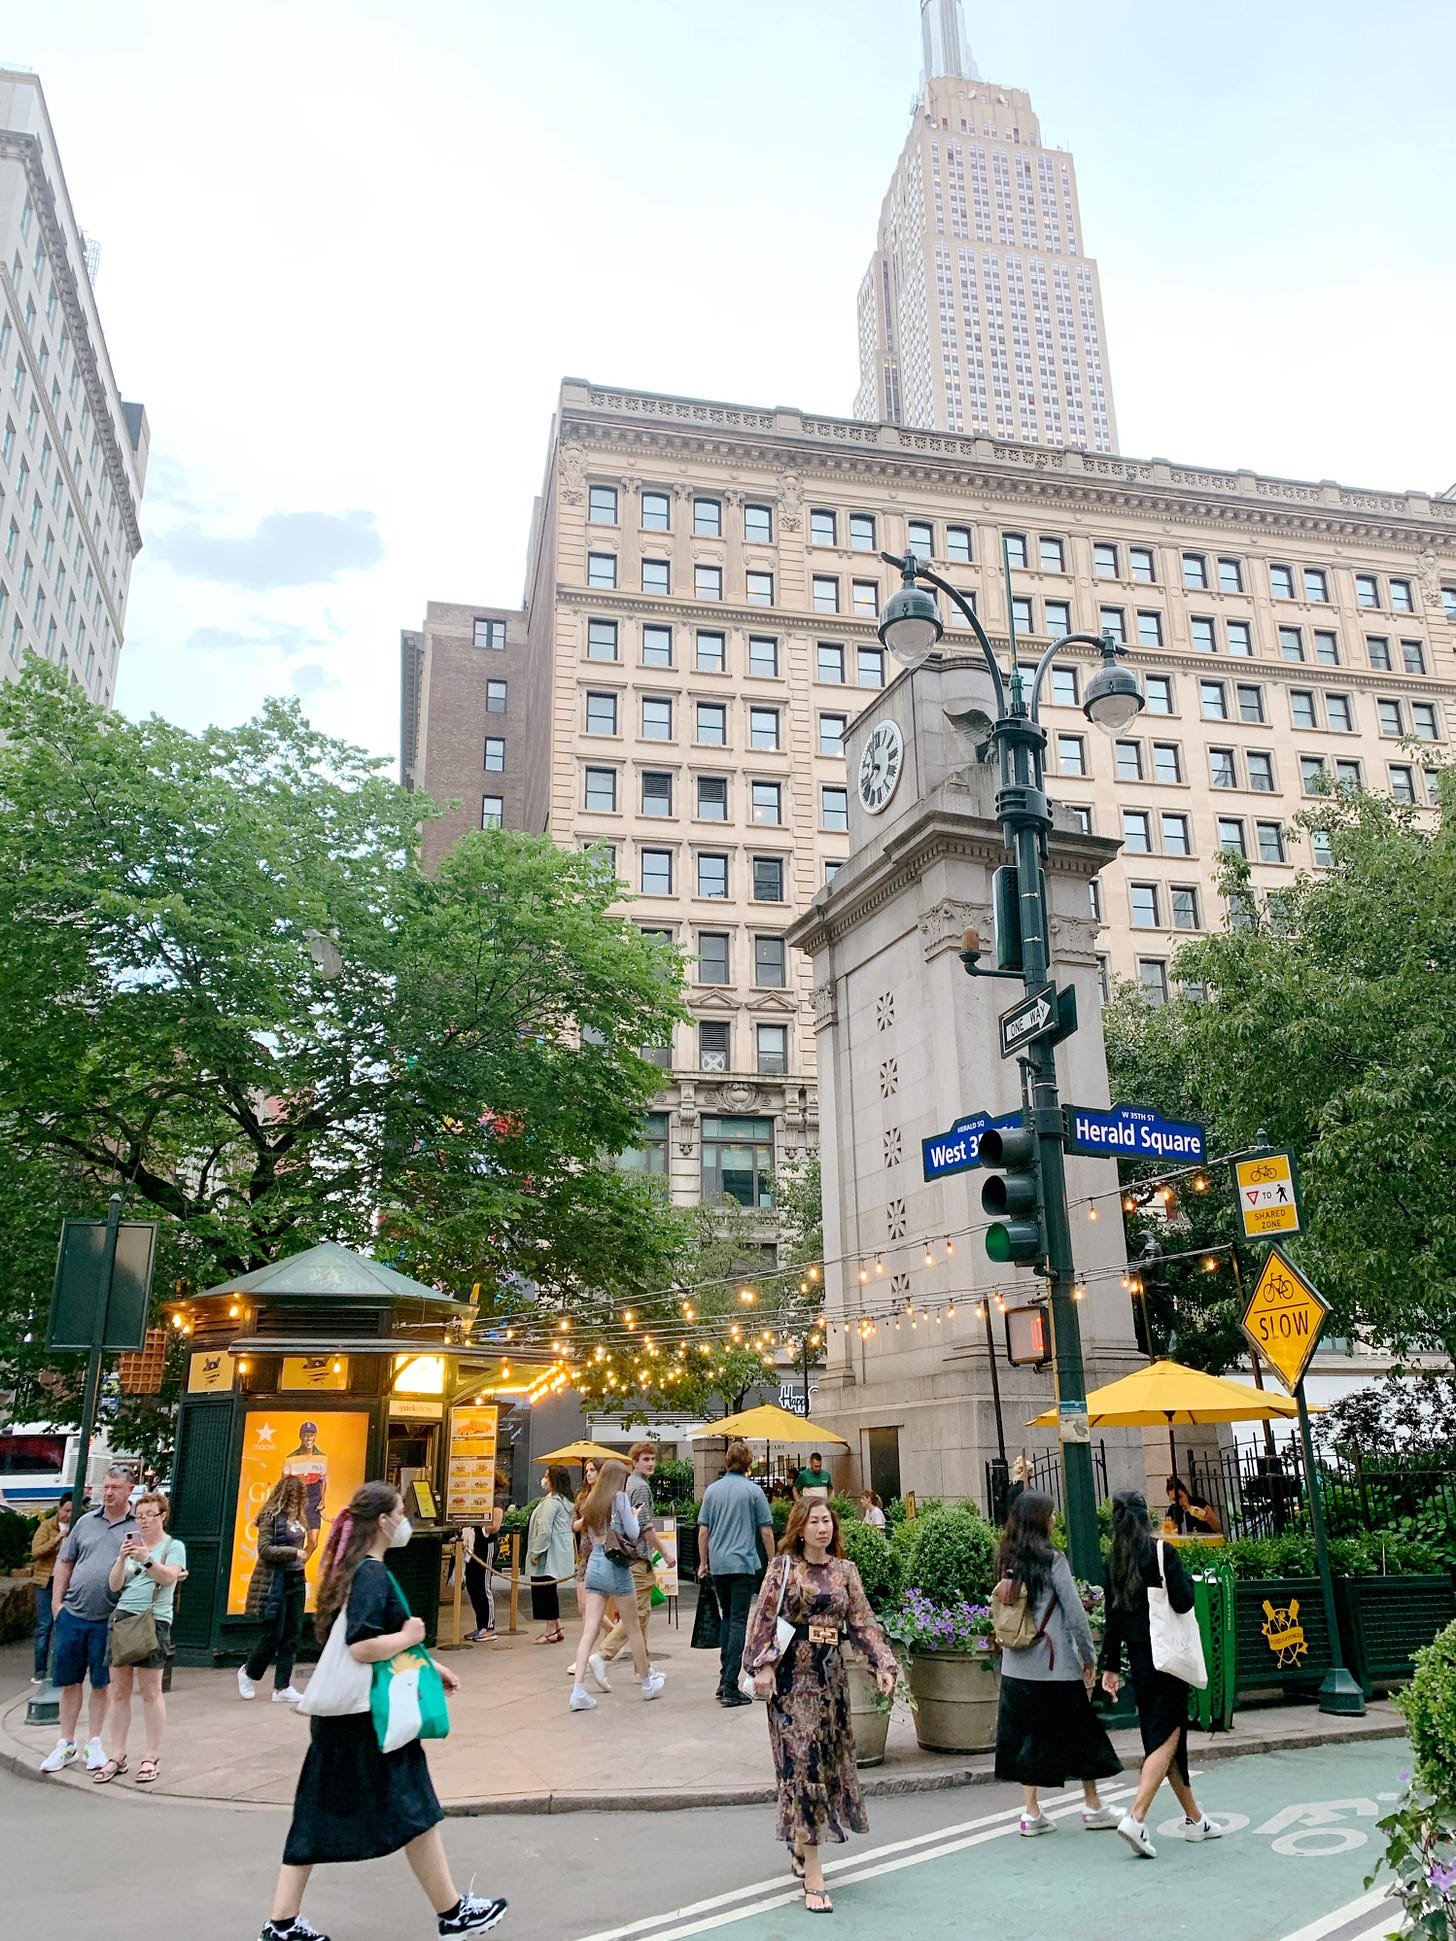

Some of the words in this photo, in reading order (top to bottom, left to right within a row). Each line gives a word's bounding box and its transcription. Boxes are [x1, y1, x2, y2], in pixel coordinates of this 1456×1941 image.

[1010, 1018, 1025, 1037] ONE
[1029, 1003, 1046, 1025] WAY
[957, 1123, 976, 1133] HERALD
[976, 1119, 985, 1128] SQ
[1121, 1111, 1129, 1119] W
[1130, 1112, 1146, 1121] 35TH
[1146, 1114, 1155, 1122] ST
[1076, 1118, 1136, 1146] Herald
[1140, 1126, 1201, 1155] Square
[930, 1140, 967, 1168] West
[1262, 1191, 1272, 1200] TO
[1254, 1209, 1286, 1221] SHARED
[1261, 1219, 1282, 1230] ZONE
[1259, 1309, 1309, 1341] SLOW
[779, 1384, 811, 1413] Happ
